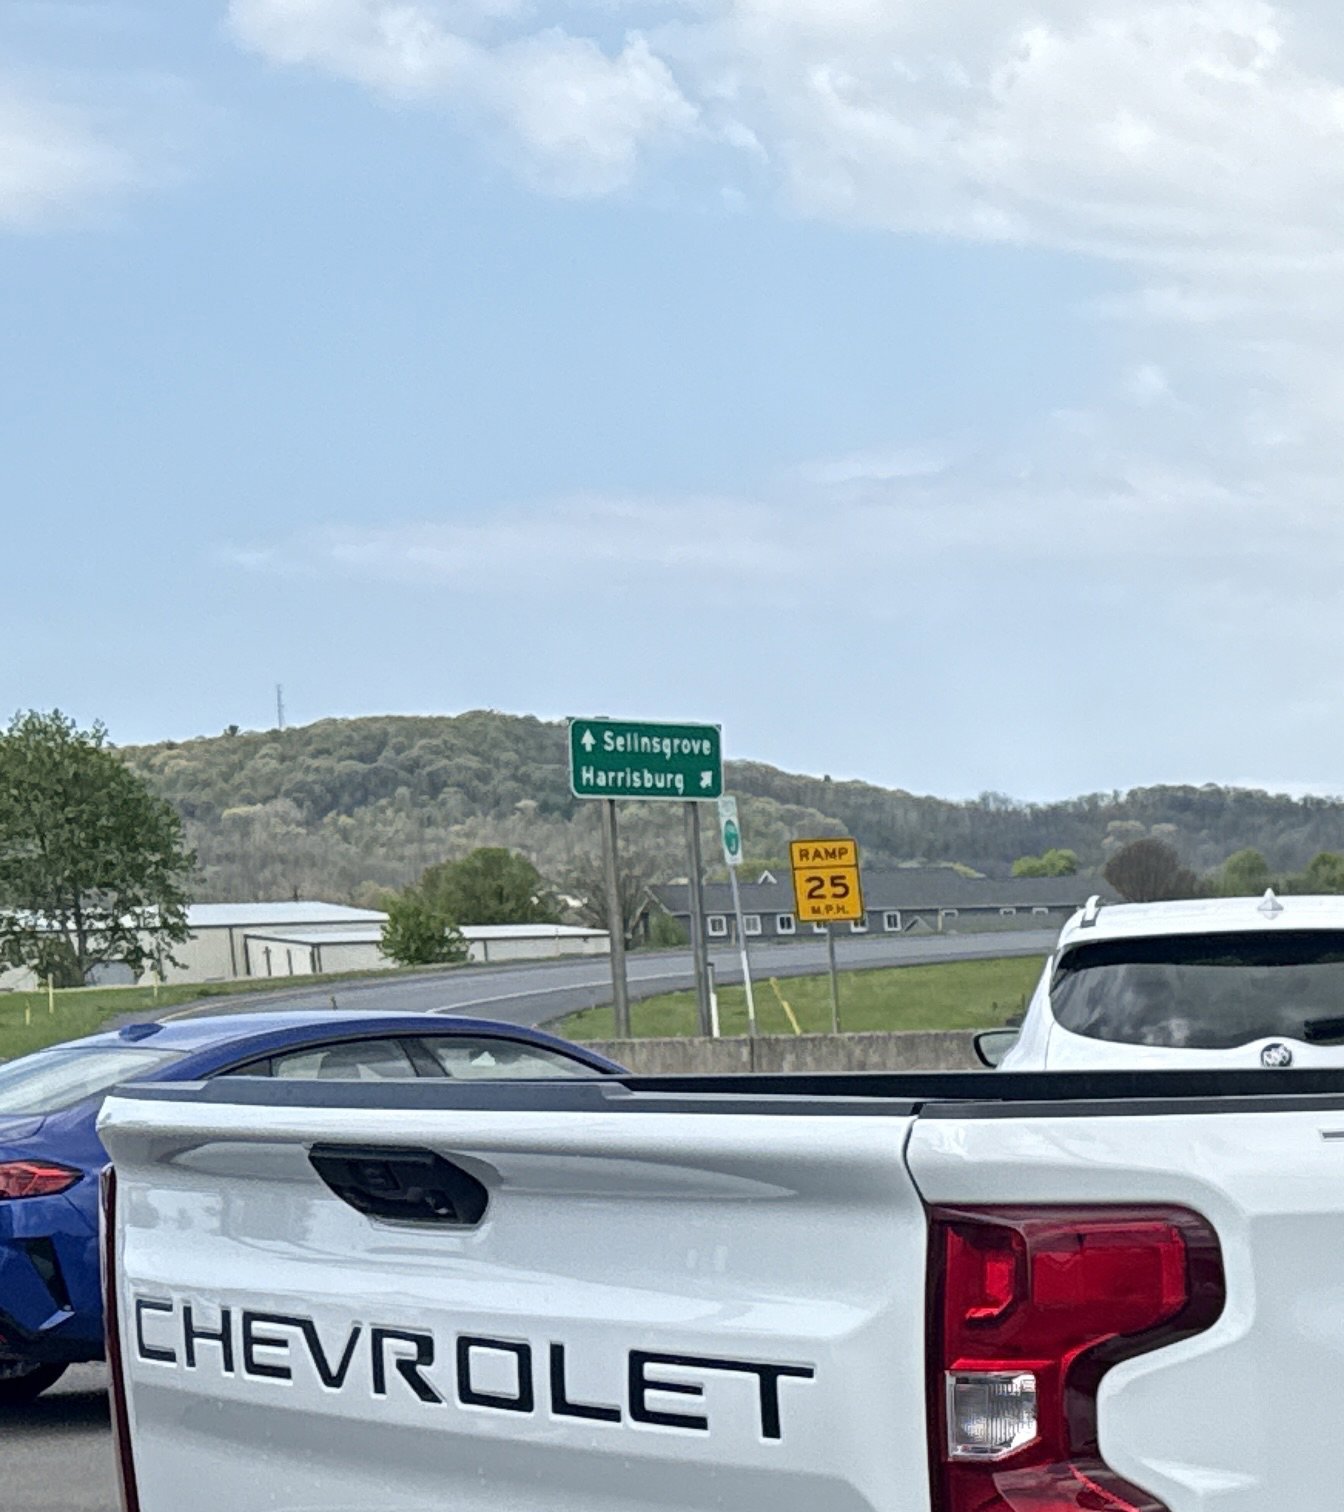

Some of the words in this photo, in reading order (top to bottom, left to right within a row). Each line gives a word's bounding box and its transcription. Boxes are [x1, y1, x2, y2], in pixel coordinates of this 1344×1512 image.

[603, 730, 711, 760] Selinsgrove
[581, 765, 684, 795] Harrisburg
[799, 847, 849, 862] RAMP
[805, 875, 850, 899] 25
[136, 1298, 815, 1440] CHEVROLET
